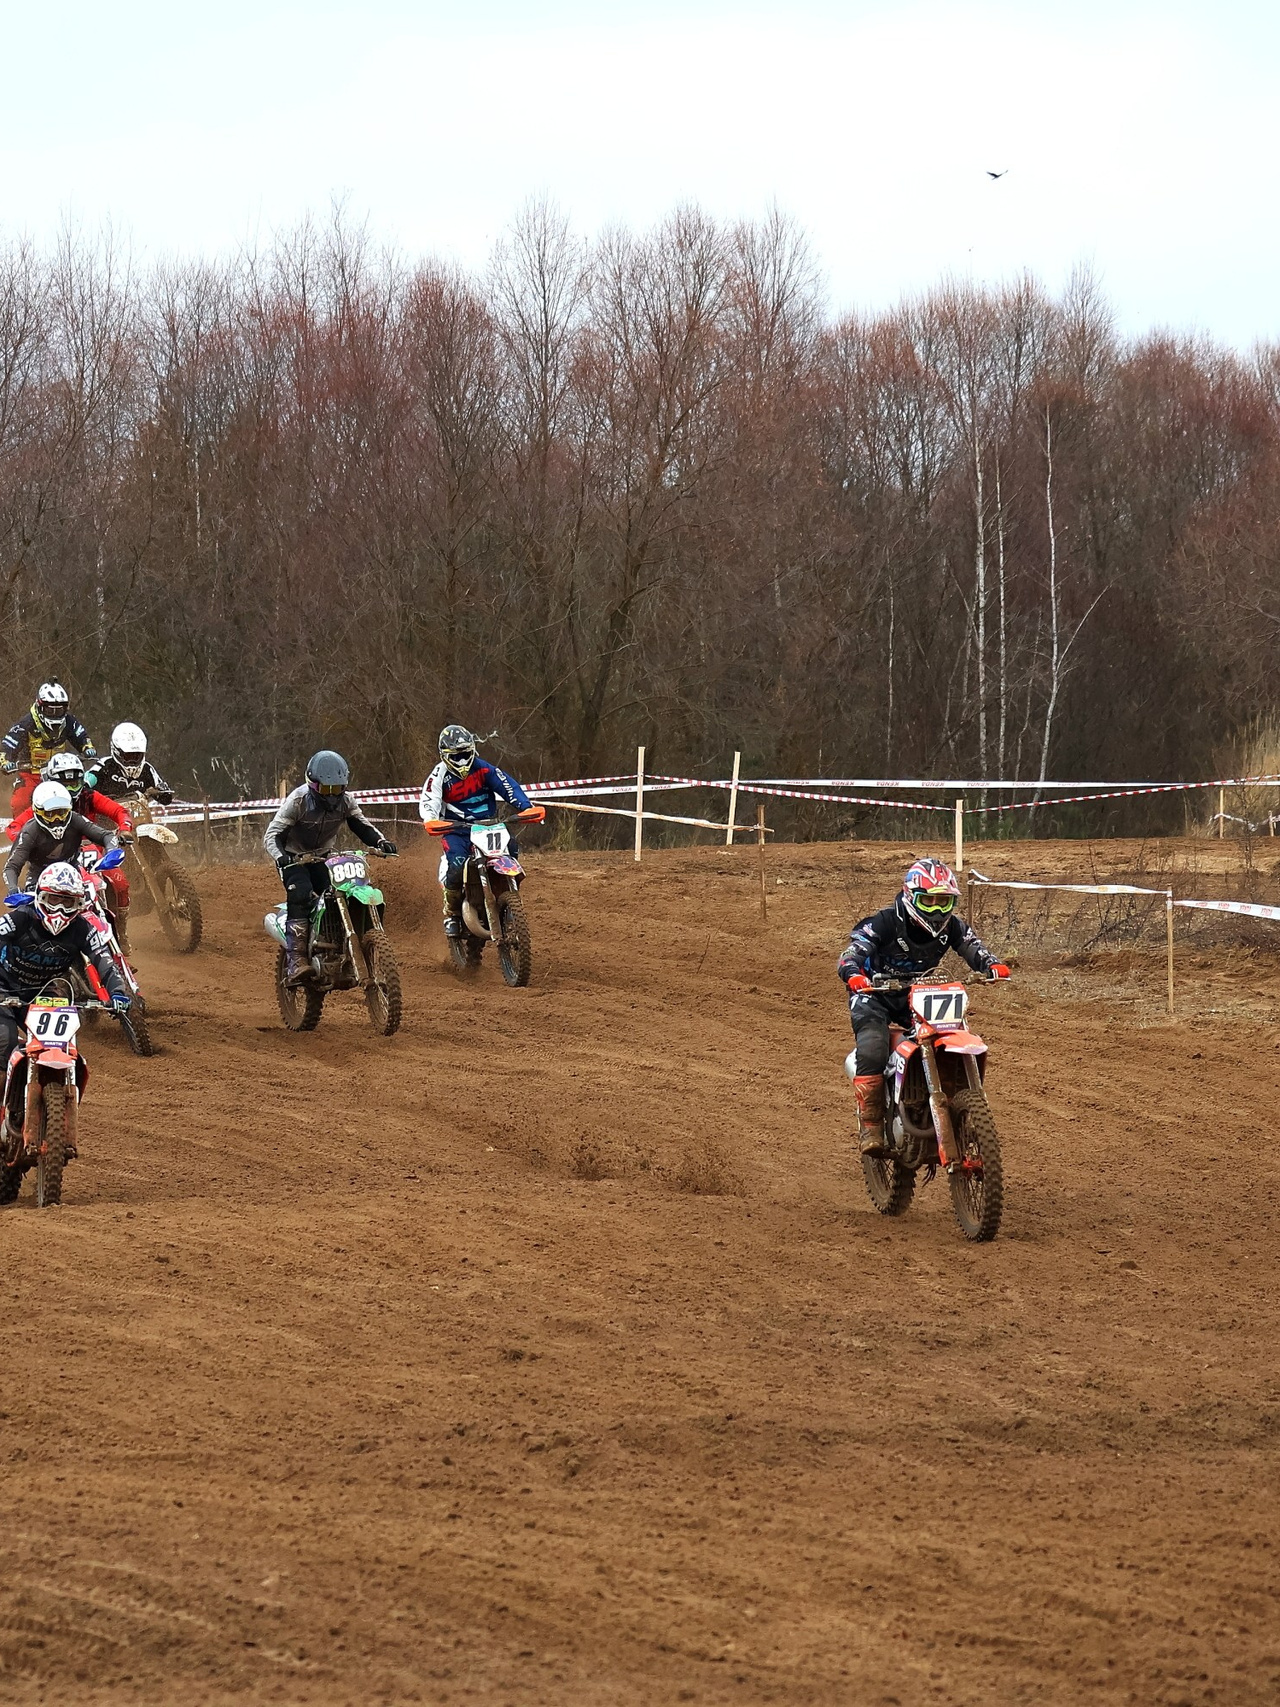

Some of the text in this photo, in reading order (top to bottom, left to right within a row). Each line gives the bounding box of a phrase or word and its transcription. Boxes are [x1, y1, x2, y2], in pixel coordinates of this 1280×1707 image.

[486, 832, 502, 851] 11
[332, 862, 366, 882] 808
[923, 993, 964, 1021] 171
[36, 1012, 70, 1036] 96
